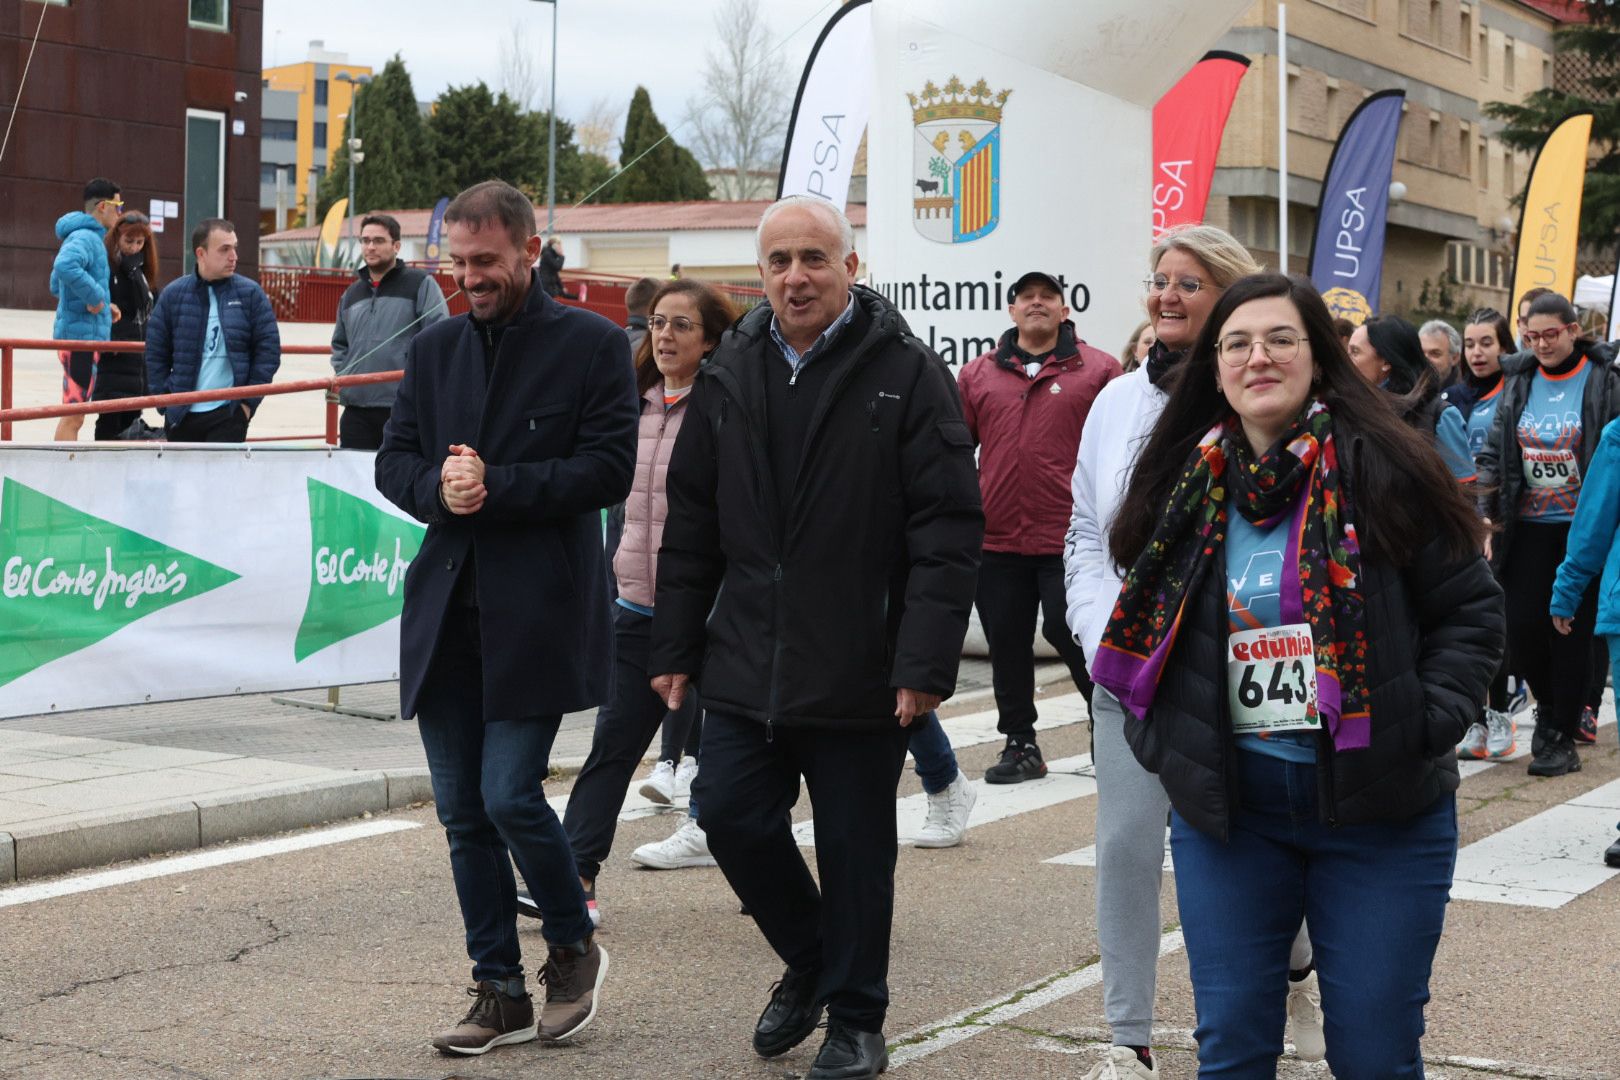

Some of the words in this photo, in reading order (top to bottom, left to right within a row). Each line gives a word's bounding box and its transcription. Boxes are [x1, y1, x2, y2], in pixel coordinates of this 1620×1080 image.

[806, 114, 846, 200] PSA
[1152, 159, 1193, 241] PSA
[1333, 187, 1367, 278] UPSA
[1532, 201, 1561, 287] UPSA
[1532, 461, 1569, 479] 650
[3, 556, 32, 598] El
[32, 557, 97, 597] Corte
[94, 546, 187, 611] Inglés
[316, 546, 338, 585] El
[339, 547, 388, 584] Corte
[1238, 659, 1308, 708] 643
